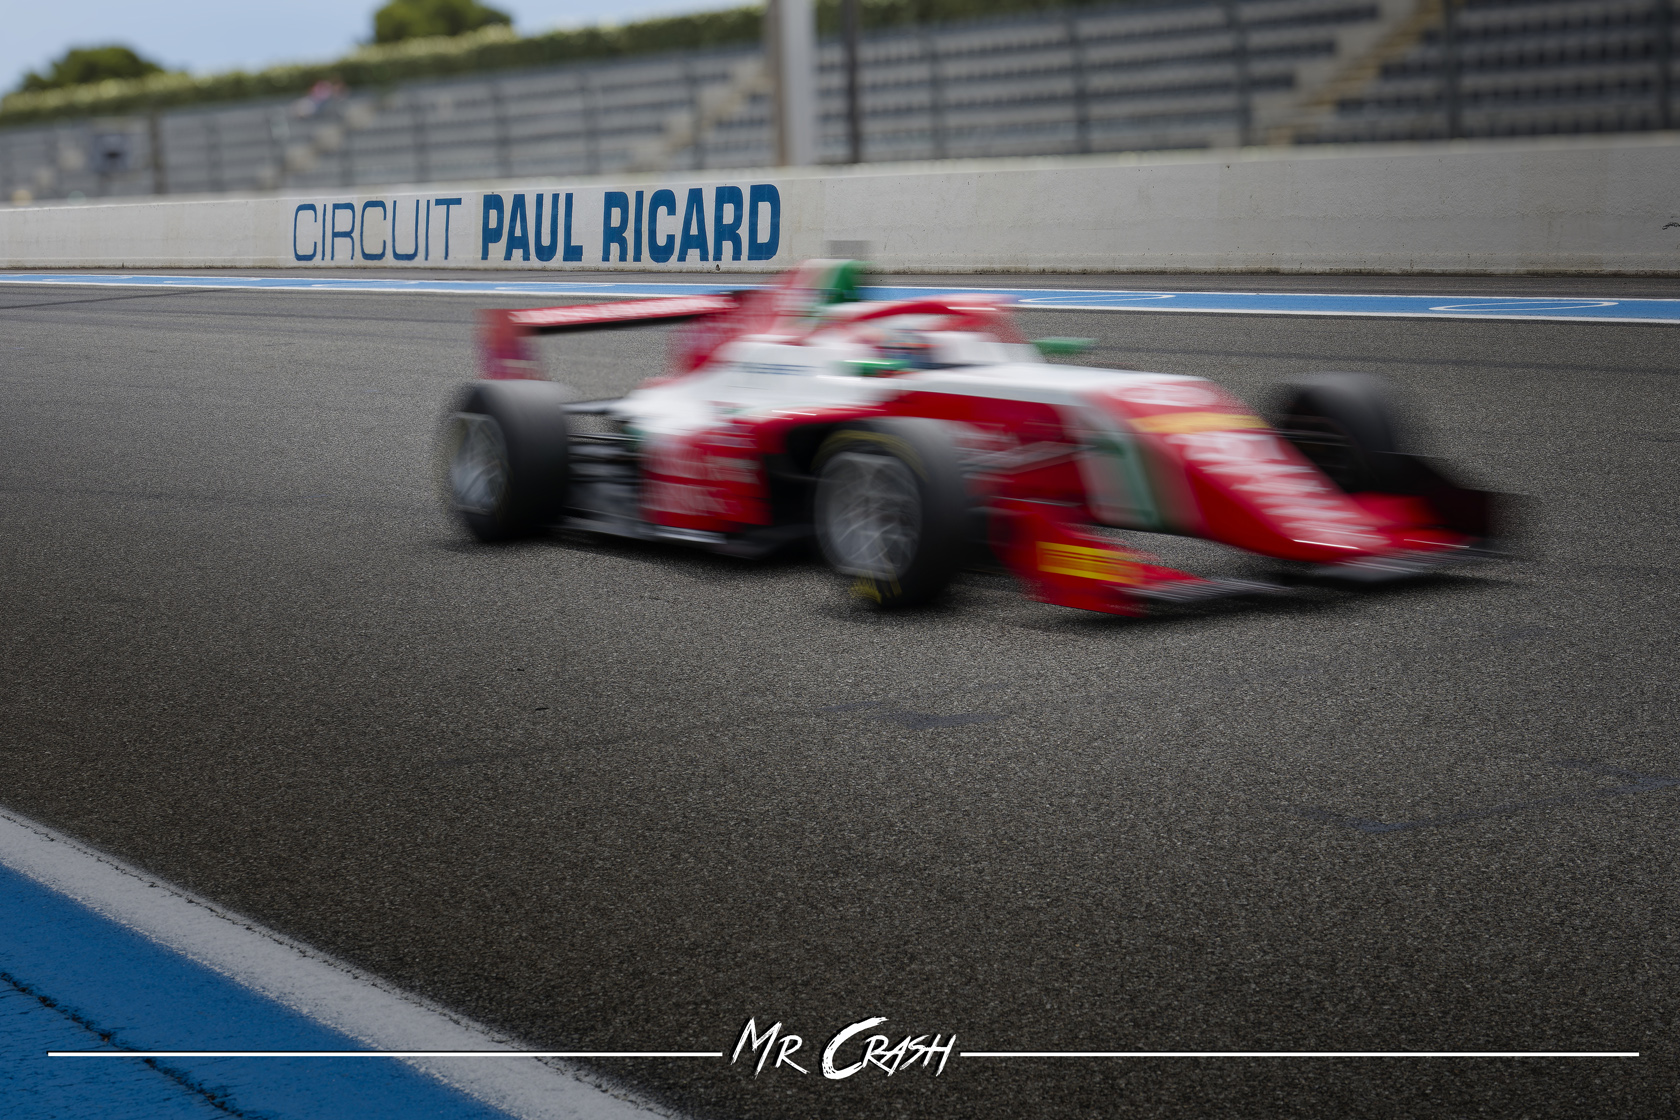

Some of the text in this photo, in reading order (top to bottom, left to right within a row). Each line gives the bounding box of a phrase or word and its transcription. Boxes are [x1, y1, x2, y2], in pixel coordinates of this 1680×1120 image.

[293, 184, 781, 263] CIRCUIT PAUL RICARD
